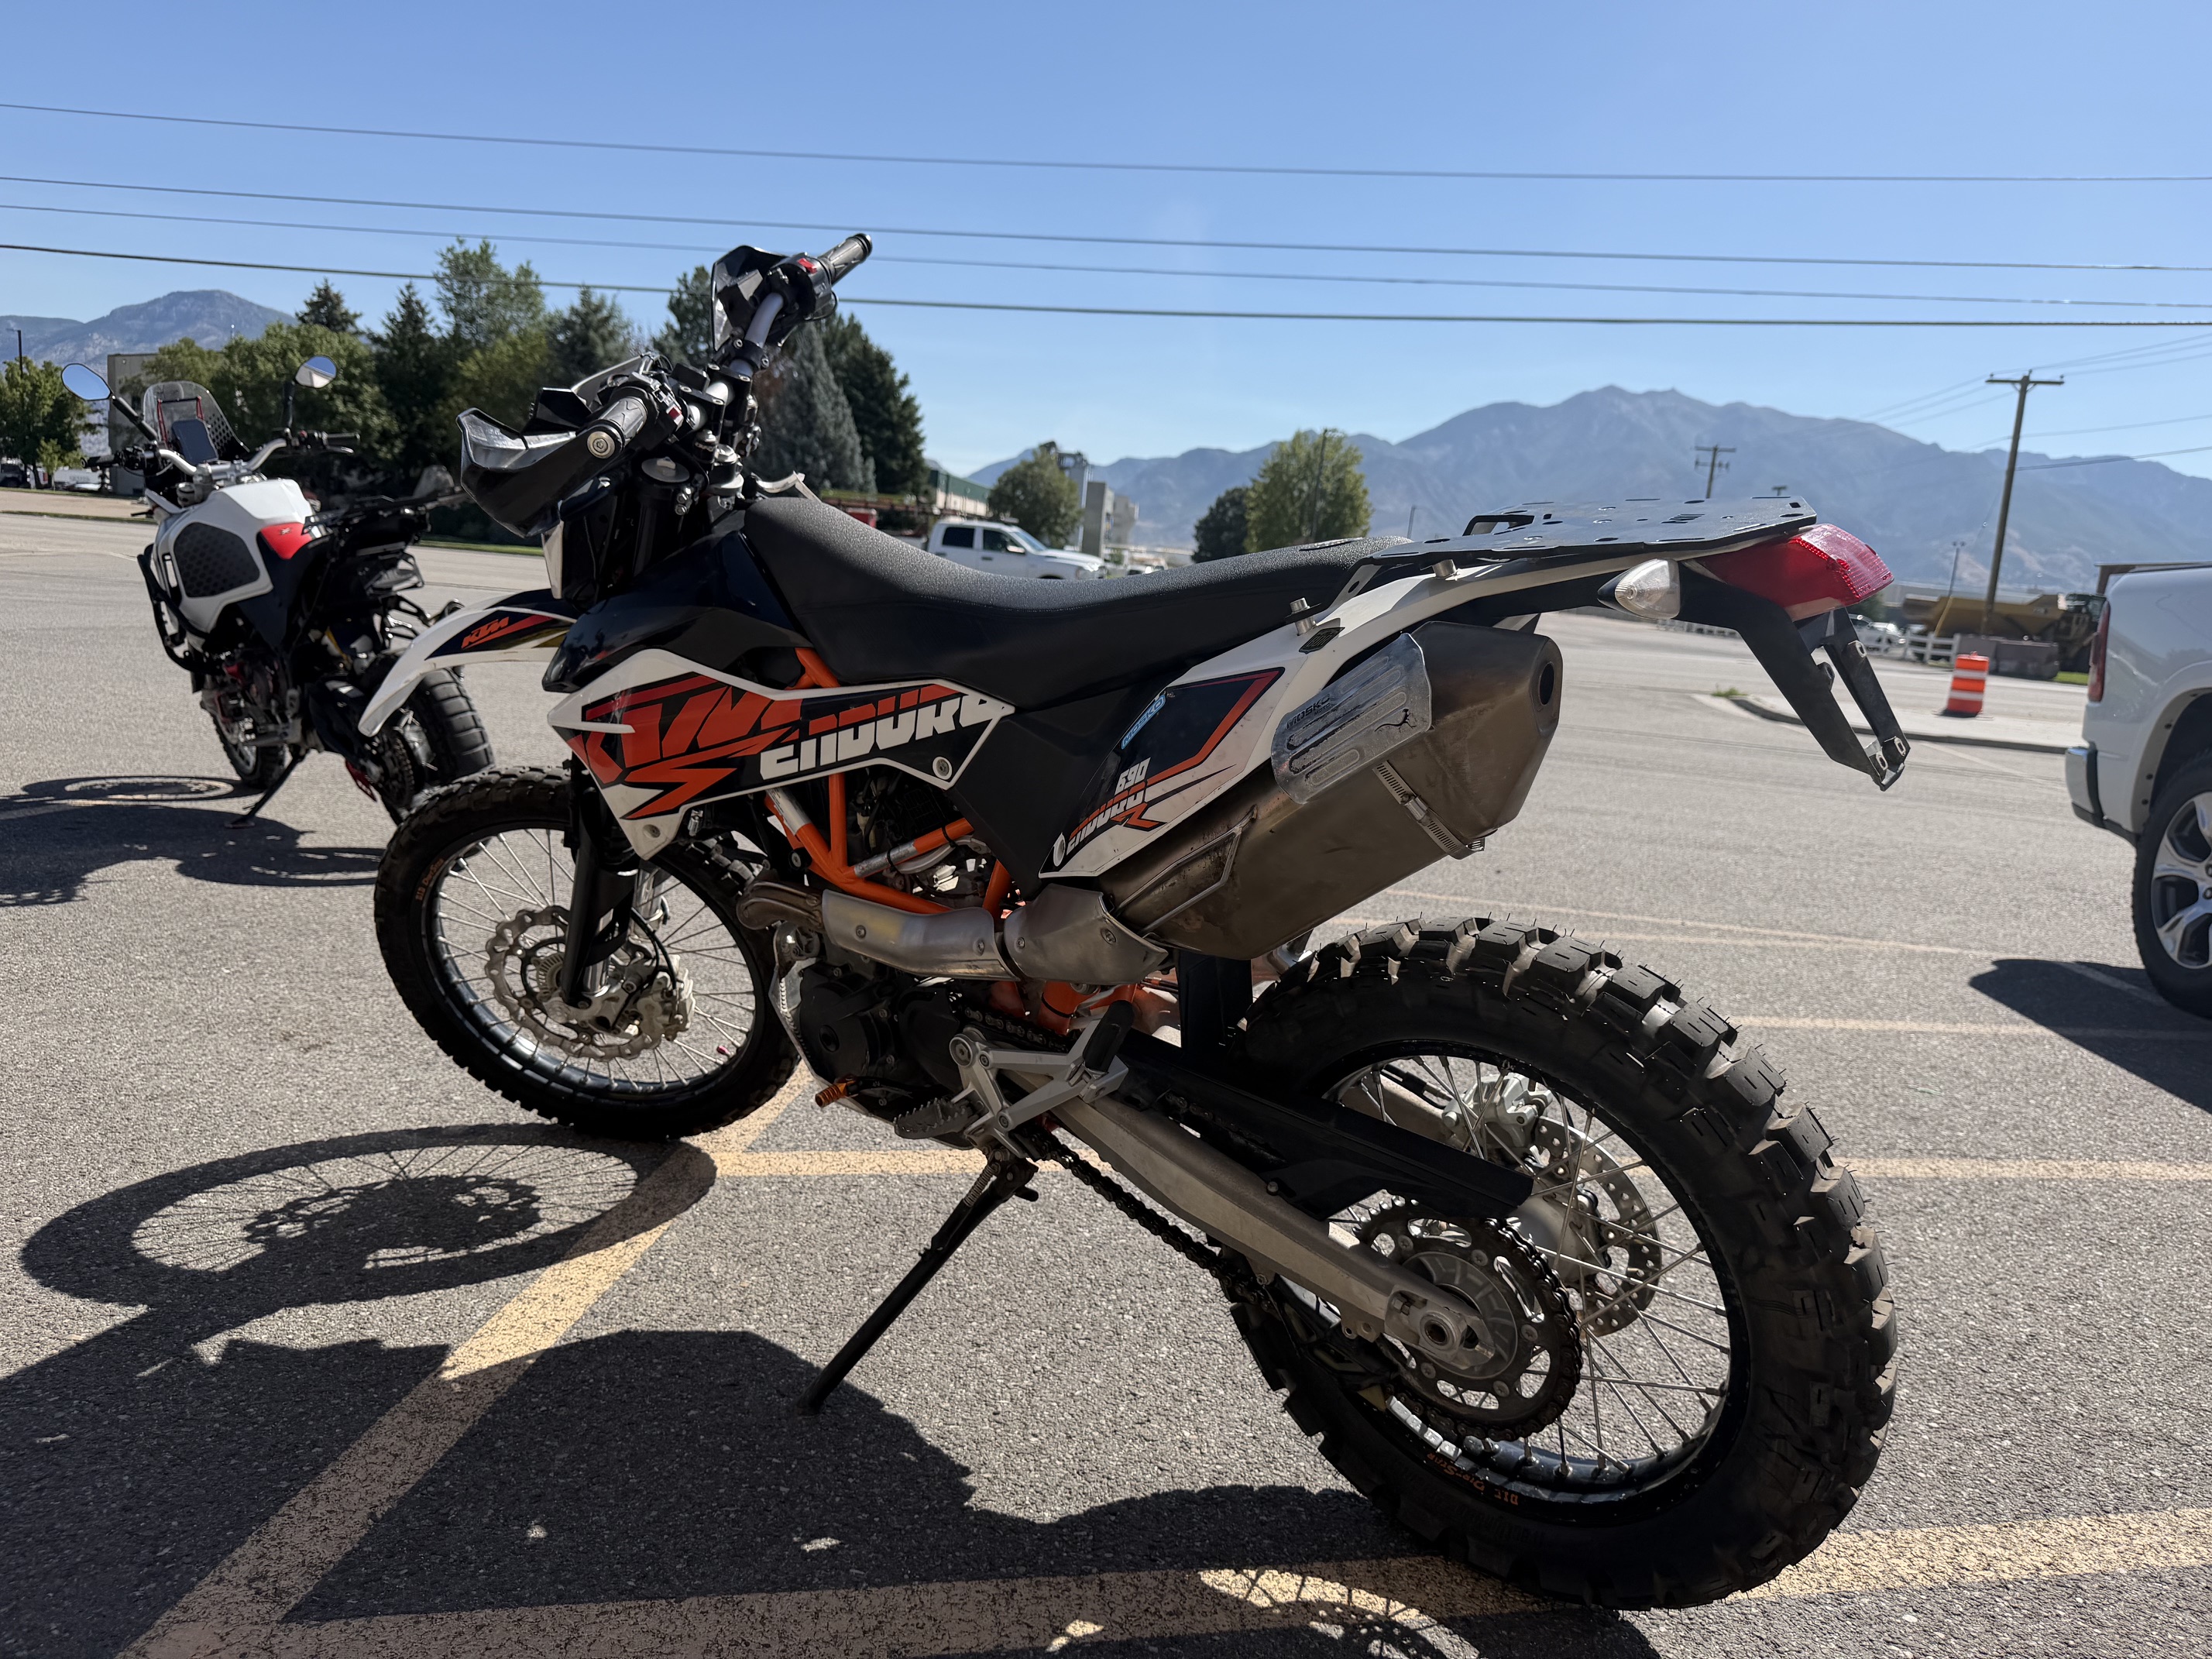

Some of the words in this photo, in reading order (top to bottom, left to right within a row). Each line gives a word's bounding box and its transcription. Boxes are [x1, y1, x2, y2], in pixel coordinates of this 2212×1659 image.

[461, 617, 510, 648] KTM
[1123, 699, 1163, 744] MOSKO
[1287, 694, 1331, 730] MOSKO
[1115, 757, 1151, 795] 690
[1066, 781, 1146, 855] ENDURO
